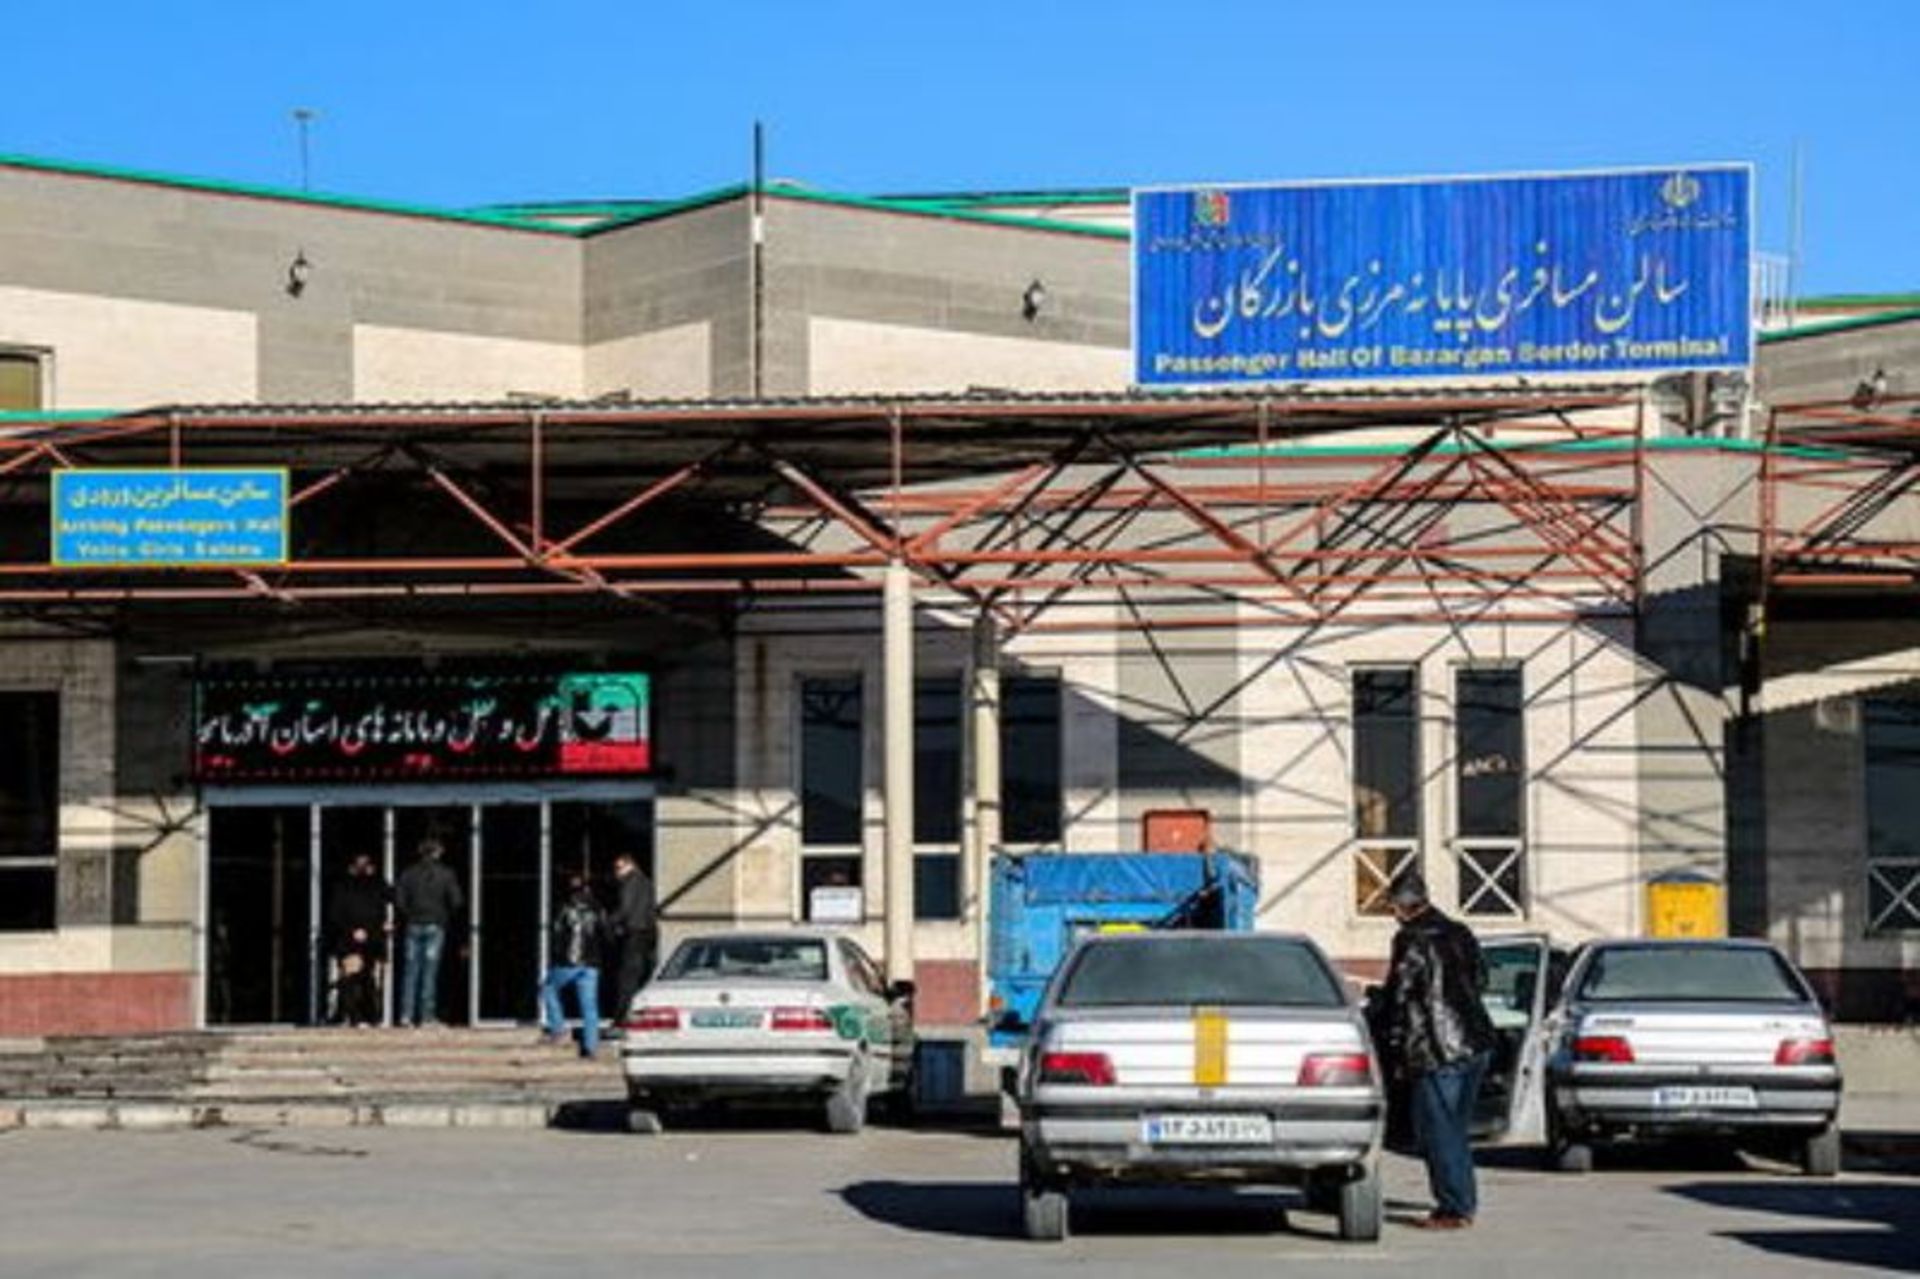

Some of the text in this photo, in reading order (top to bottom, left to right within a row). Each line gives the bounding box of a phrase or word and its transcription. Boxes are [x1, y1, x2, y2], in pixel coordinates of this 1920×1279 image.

[1193, 243, 1313, 340] بازرگان
[1316, 257, 1405, 338] مرزی
[1475, 238, 1598, 331] مسافری
[1594, 252, 1689, 333] سالن
[1155, 333, 1730, 376] Passenger Hall Of Bazargan Border Terminal
